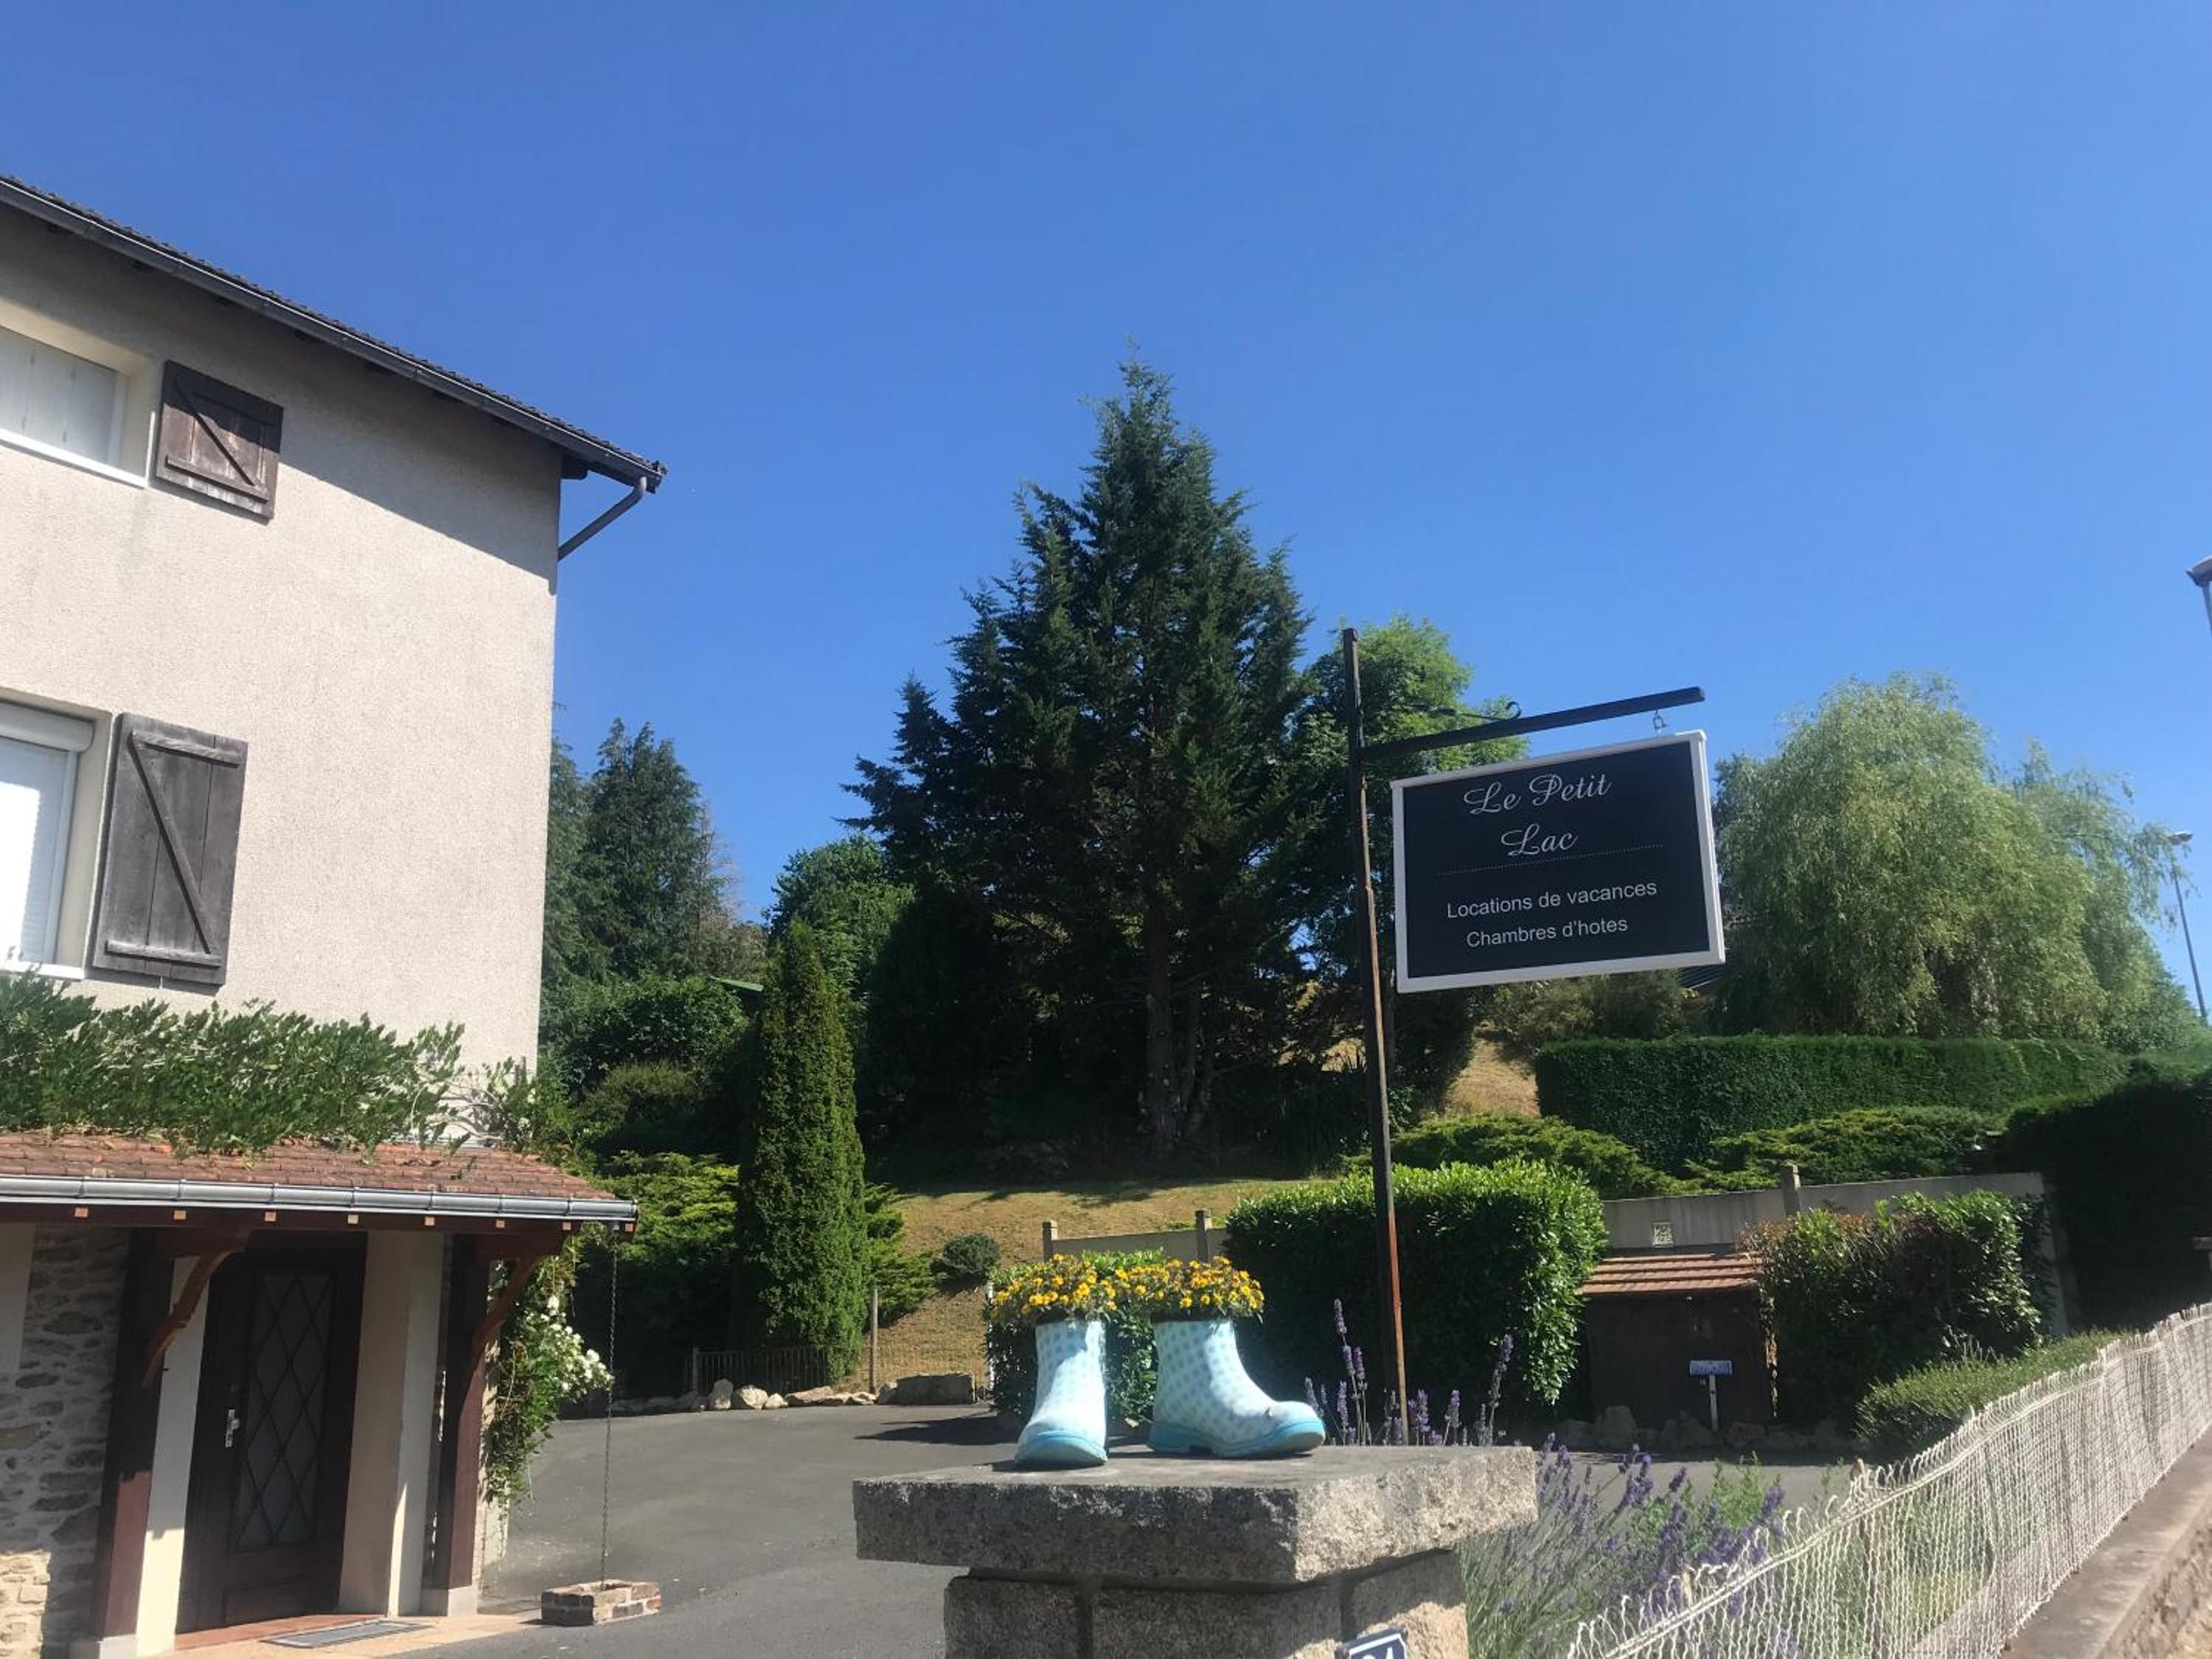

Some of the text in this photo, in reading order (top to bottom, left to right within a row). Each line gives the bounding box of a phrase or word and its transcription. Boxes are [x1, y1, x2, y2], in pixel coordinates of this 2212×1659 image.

[1464, 773, 1612, 815] Le Petit
[1500, 824, 1578, 856] Lac
[1447, 882, 1658, 918] Locations de vacances
[1467, 918, 1628, 947] Chambres d'hotes
